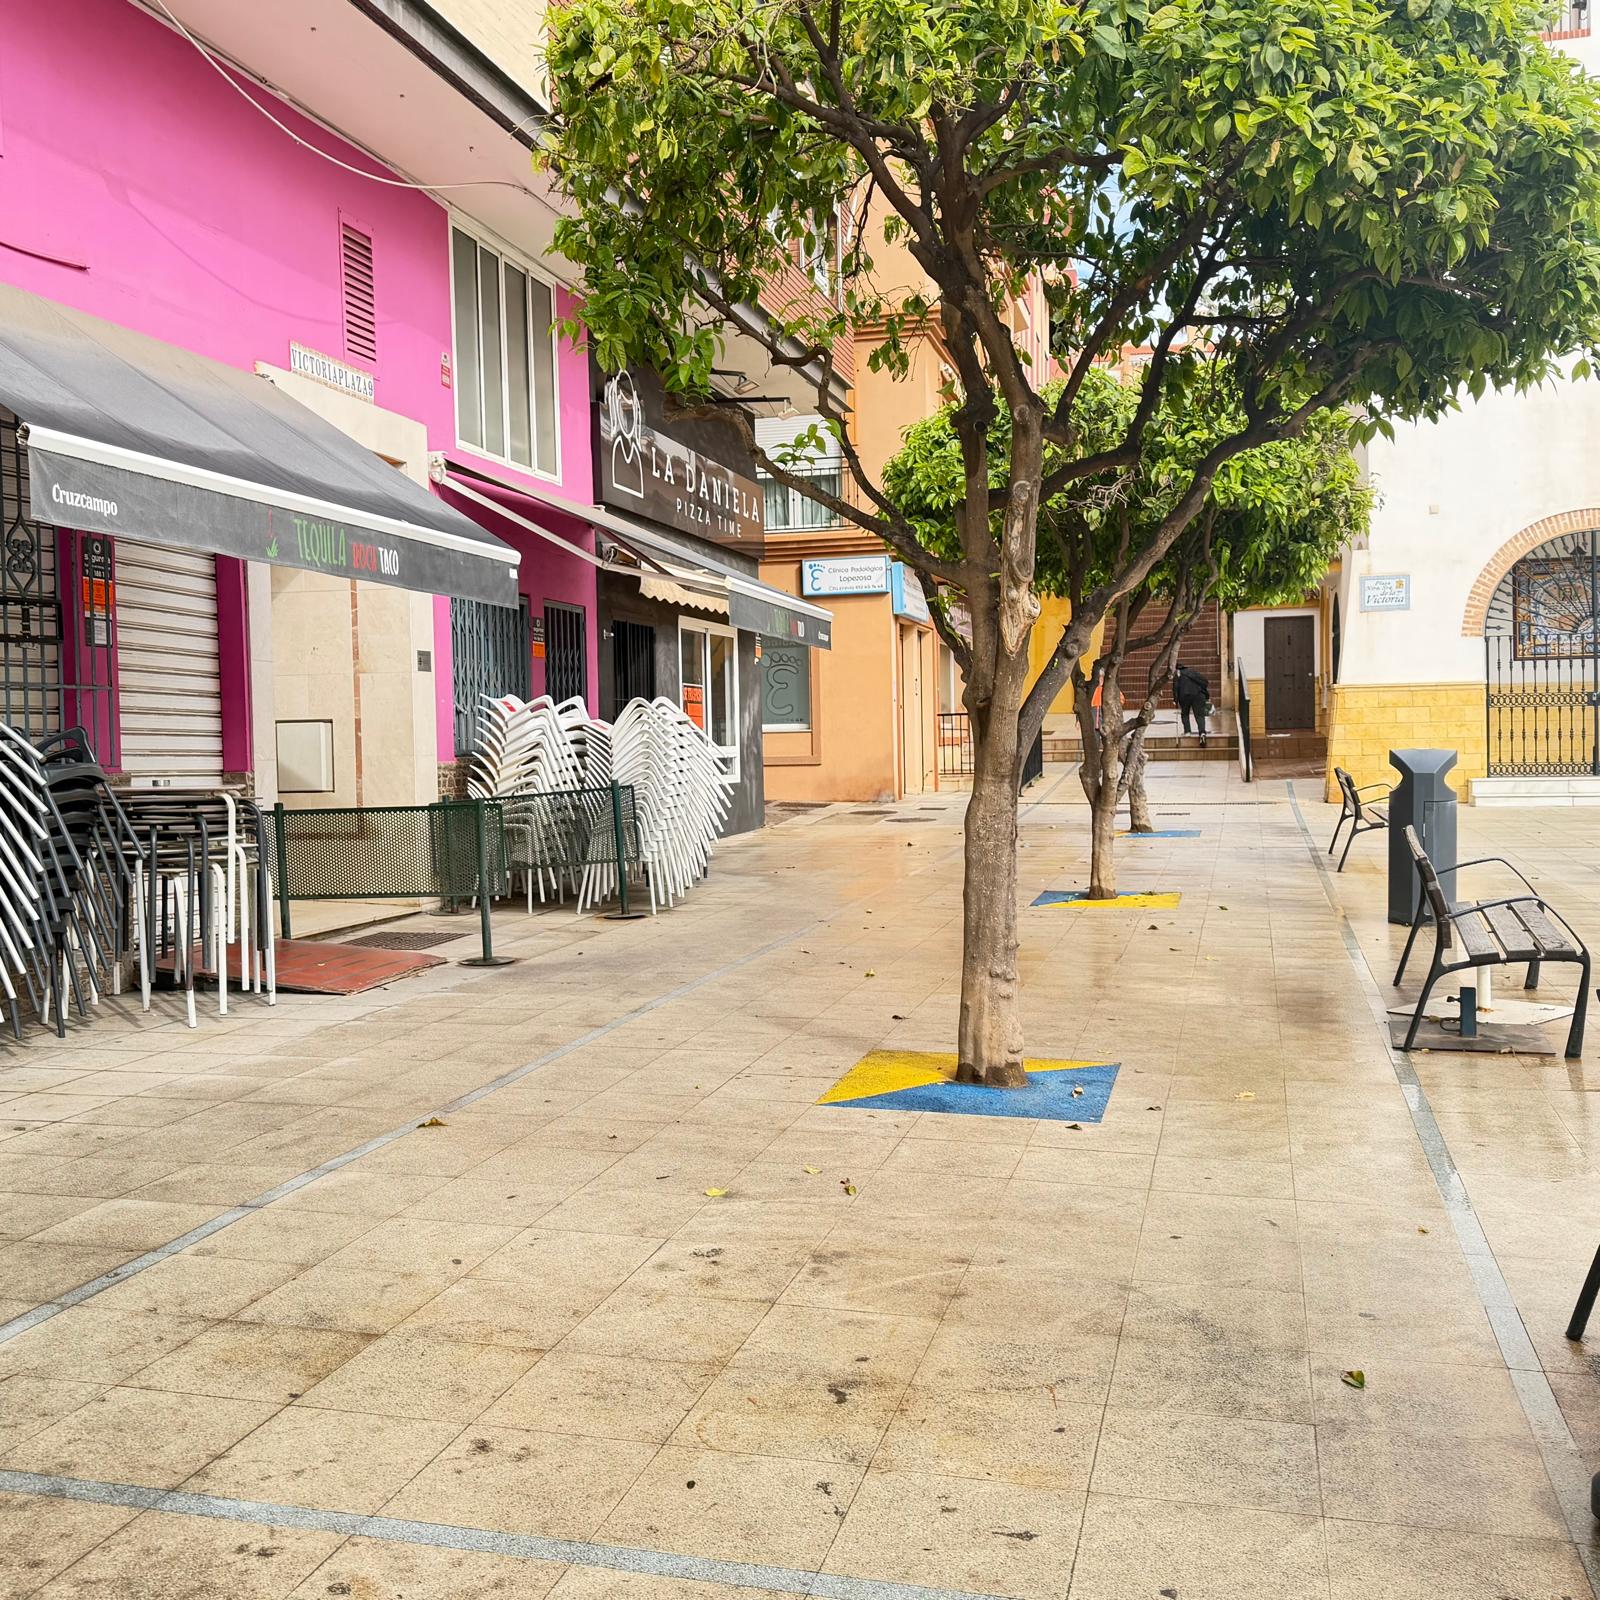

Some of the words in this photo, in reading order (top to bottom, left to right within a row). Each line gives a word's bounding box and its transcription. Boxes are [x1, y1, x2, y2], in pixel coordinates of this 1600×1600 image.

[52, 482, 118, 517] Cruzcampo
[651, 446, 675, 485] LA
[685, 463, 760, 523] DANIELA
[676, 497, 711, 526] PIZZA
[717, 515, 741, 538] TIME
[291, 518, 347, 567] TEQUILA
[378, 547, 399, 576] TACO
[1367, 595, 1404, 604] Victoria
